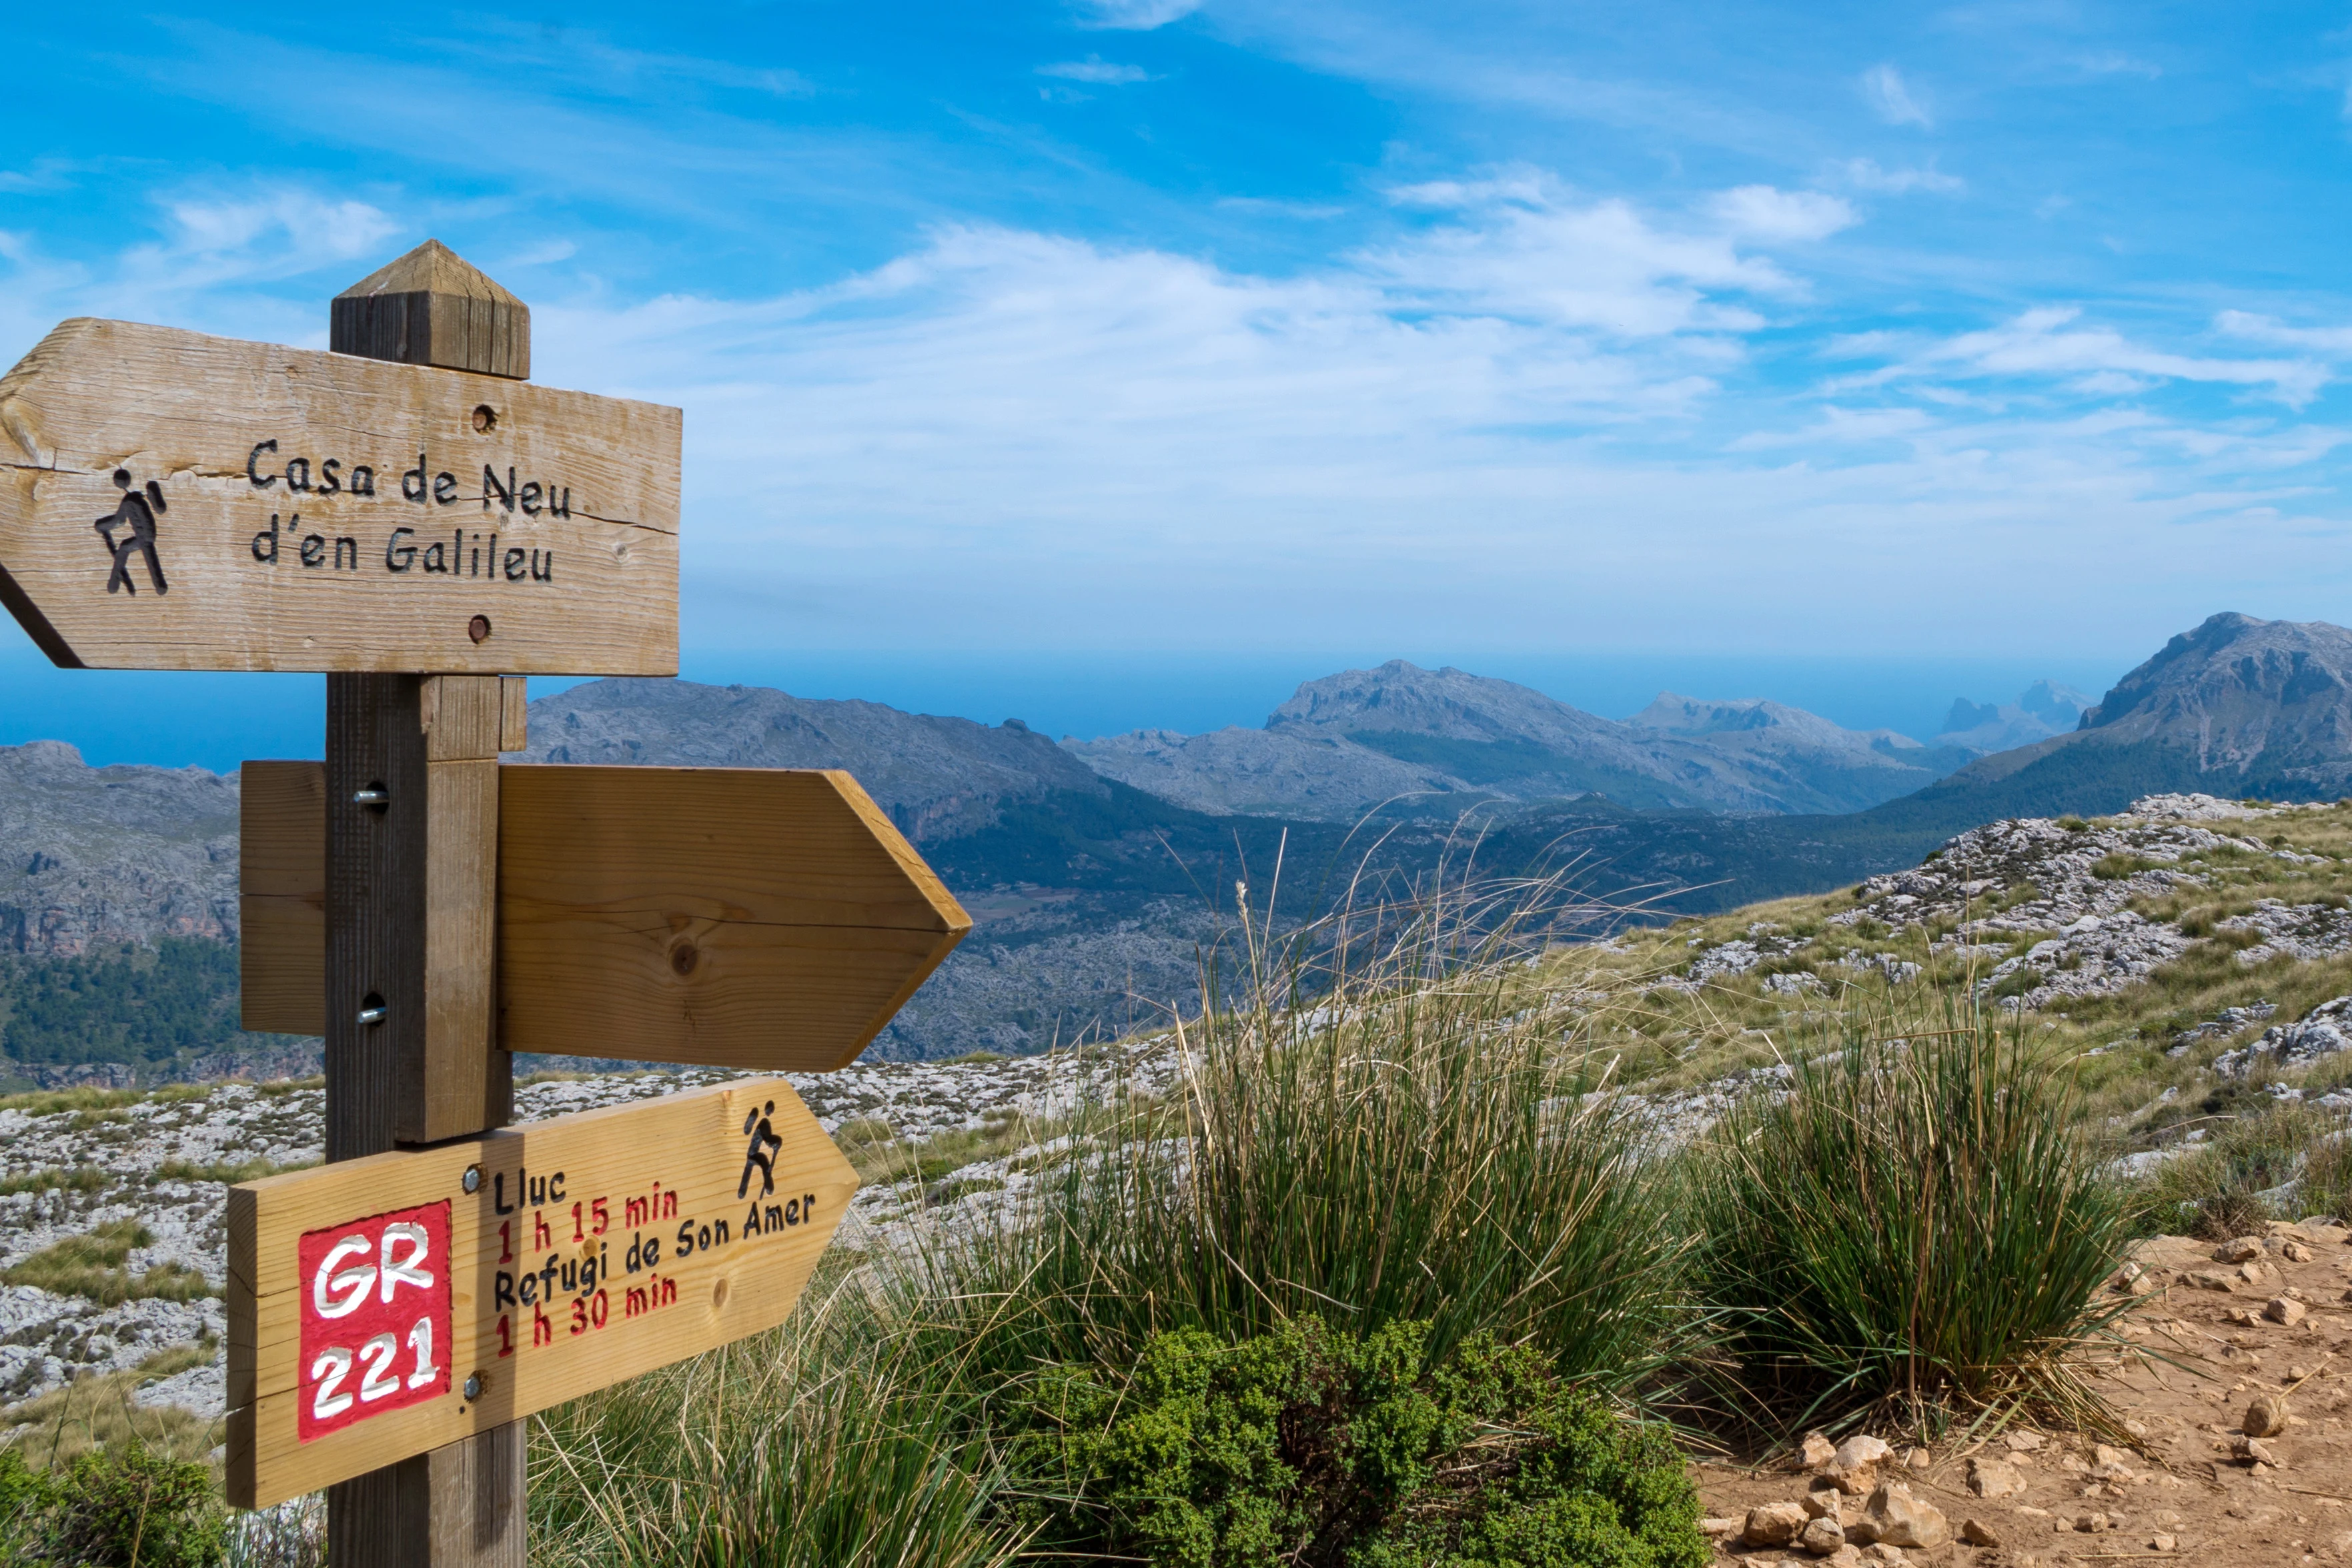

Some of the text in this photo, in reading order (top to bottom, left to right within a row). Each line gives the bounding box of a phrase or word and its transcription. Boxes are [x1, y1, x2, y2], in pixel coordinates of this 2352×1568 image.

[247, 439, 570, 520] Casa de Neu
[251, 514, 552, 582] d'en Galileu
[494, 1168, 566, 1215] Lluc
[498, 1181, 678, 1264] 1 h 15 min
[314, 1222, 434, 1319] GR
[495, 1193, 816, 1313] Refugi de Son Amer
[496, 1273, 677, 1358] 1 h 30 min
[312, 1316, 440, 1420] 221
